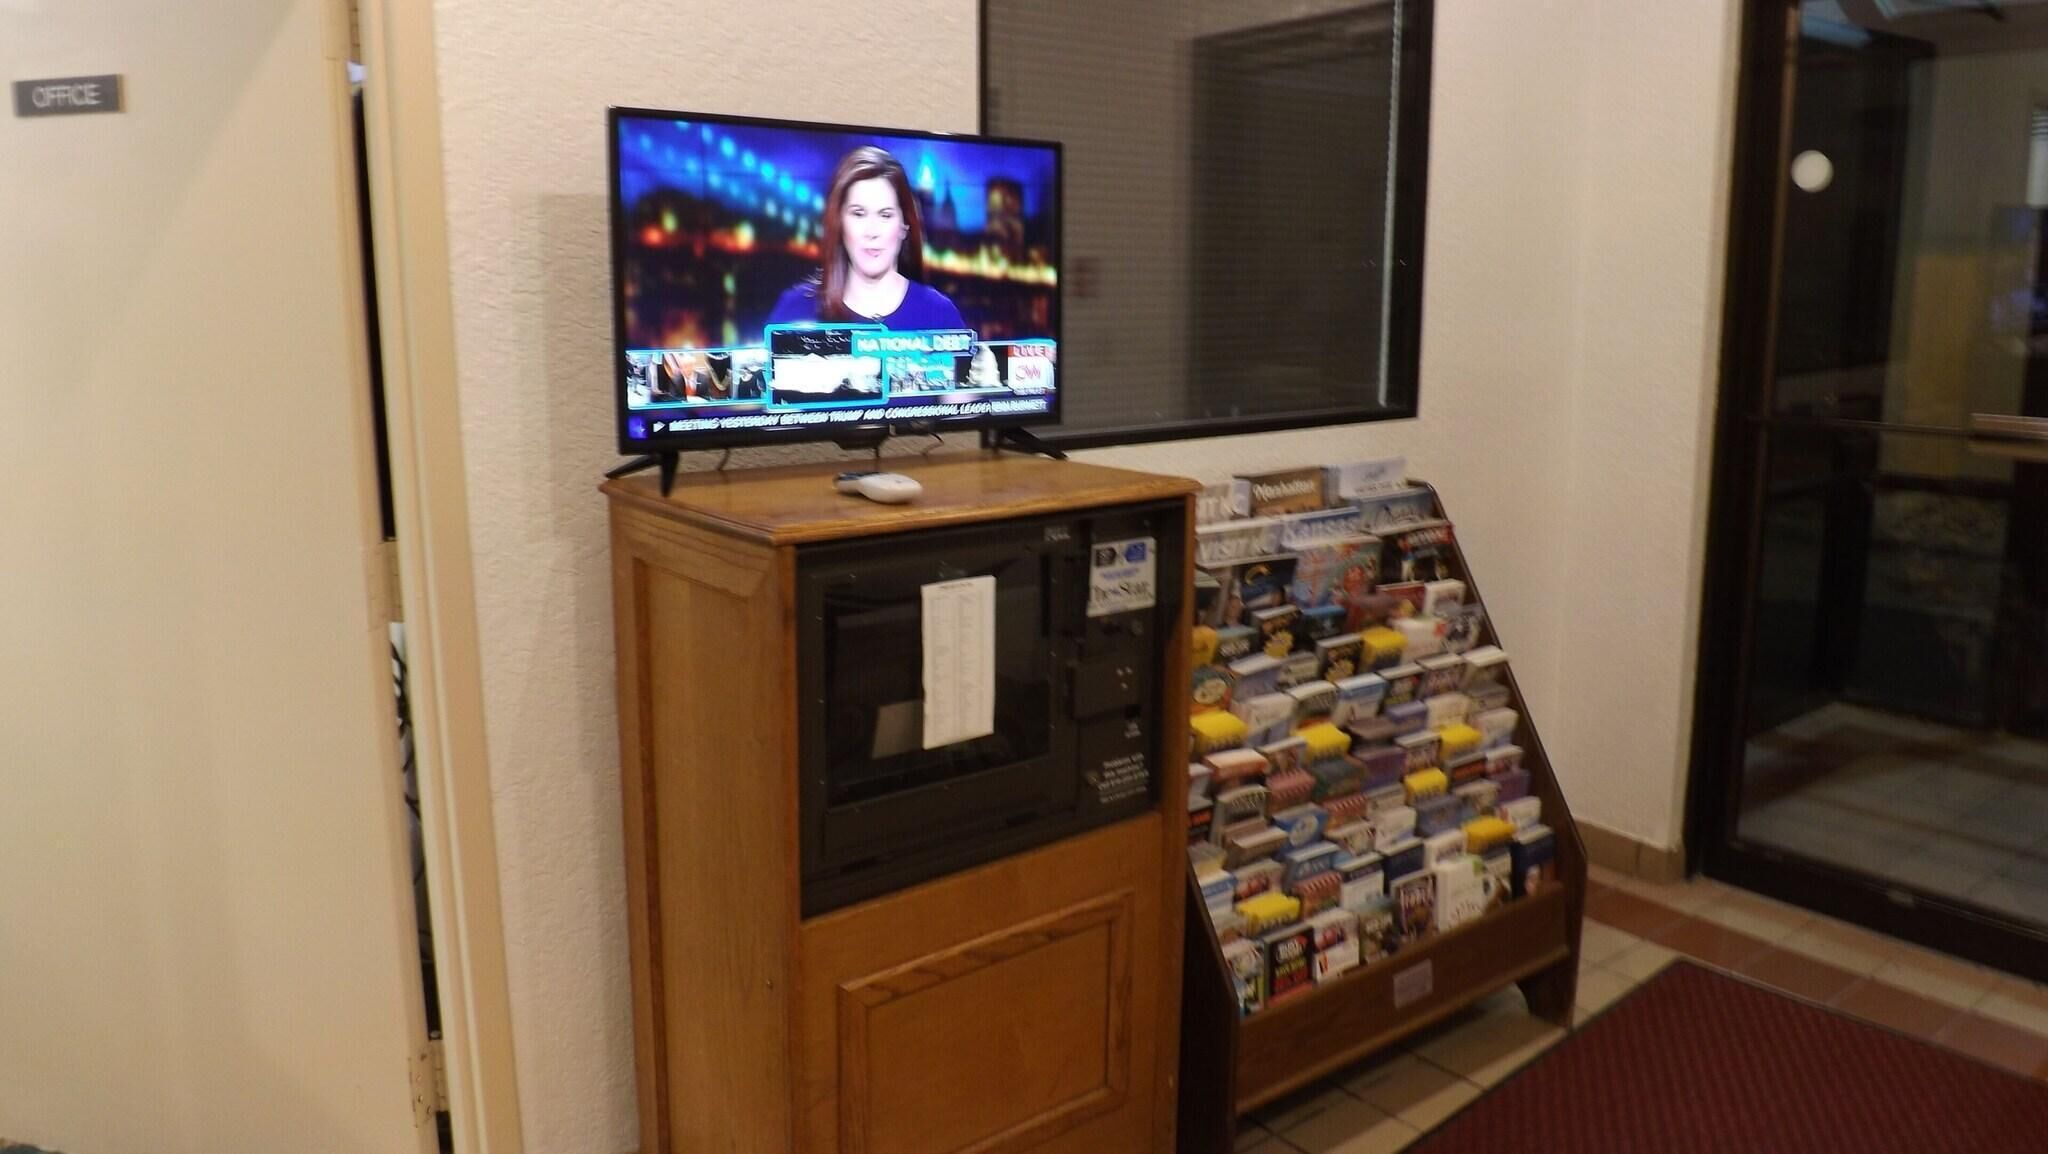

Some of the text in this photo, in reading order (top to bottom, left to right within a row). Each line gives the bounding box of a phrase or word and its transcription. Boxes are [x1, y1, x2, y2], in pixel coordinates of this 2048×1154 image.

[31, 83, 102, 108] OFFICE
[857, 333, 972, 353] NATIONAL DEBT
[669, 418, 720, 432] MEETING
[721, 414, 780, 429] YESTERDAY
[780, 411, 830, 425] BETWEEN
[830, 409, 863, 422] TRUMP
[863, 408, 885, 421] AND
[885, 404, 959, 419] CONGRESSIONAL
